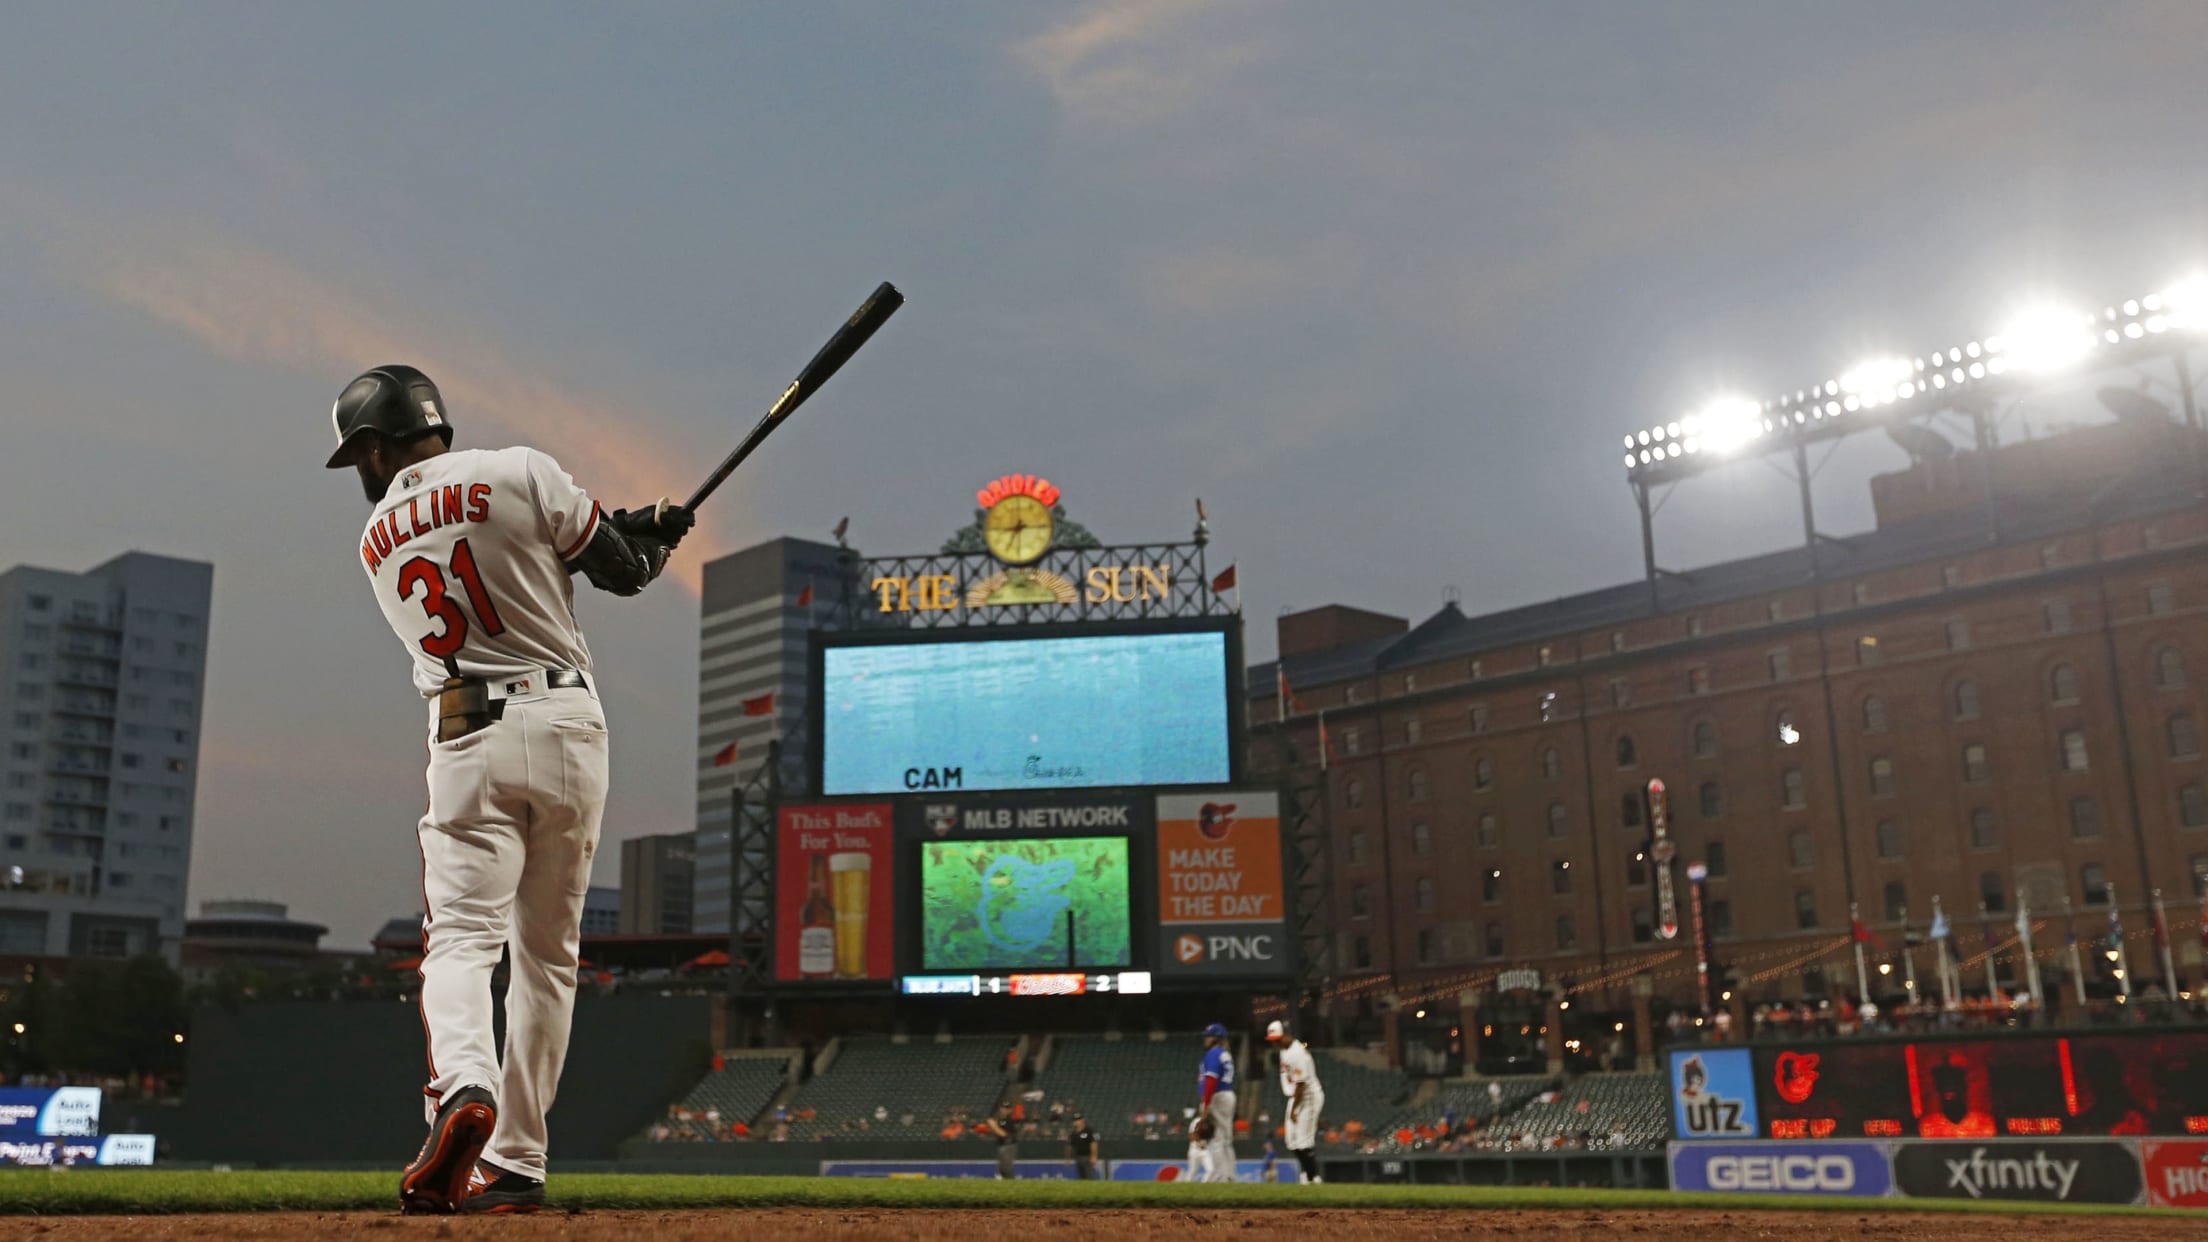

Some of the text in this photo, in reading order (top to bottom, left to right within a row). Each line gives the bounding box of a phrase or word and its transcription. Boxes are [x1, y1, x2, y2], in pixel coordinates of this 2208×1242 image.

[977, 474, 1060, 508] ORIOLES
[361, 483, 491, 575] MULLINS
[397, 537, 505, 657] 31
[871, 565, 1170, 612] THE SUN
[904, 767, 962, 790] CAM
[790, 810, 882, 830] This Bud's
[964, 806, 1128, 830] MLB NETWORK
[800, 831, 872, 850] For You.
[1169, 848, 1236, 869] MAKE
[1169, 871, 1242, 893] TODAY
[1169, 895, 1264, 917] THE DAY
[1208, 934, 1273, 961] PNC
[987, 976, 1001, 994] 1
[1095, 974, 1111, 992] 2
[1687, 1096, 1743, 1133] utz
[1809, 1118, 1837, 1138] UP
[1706, 1155, 1856, 1191] GEICO
[1944, 1147, 2080, 1199] xfinity
